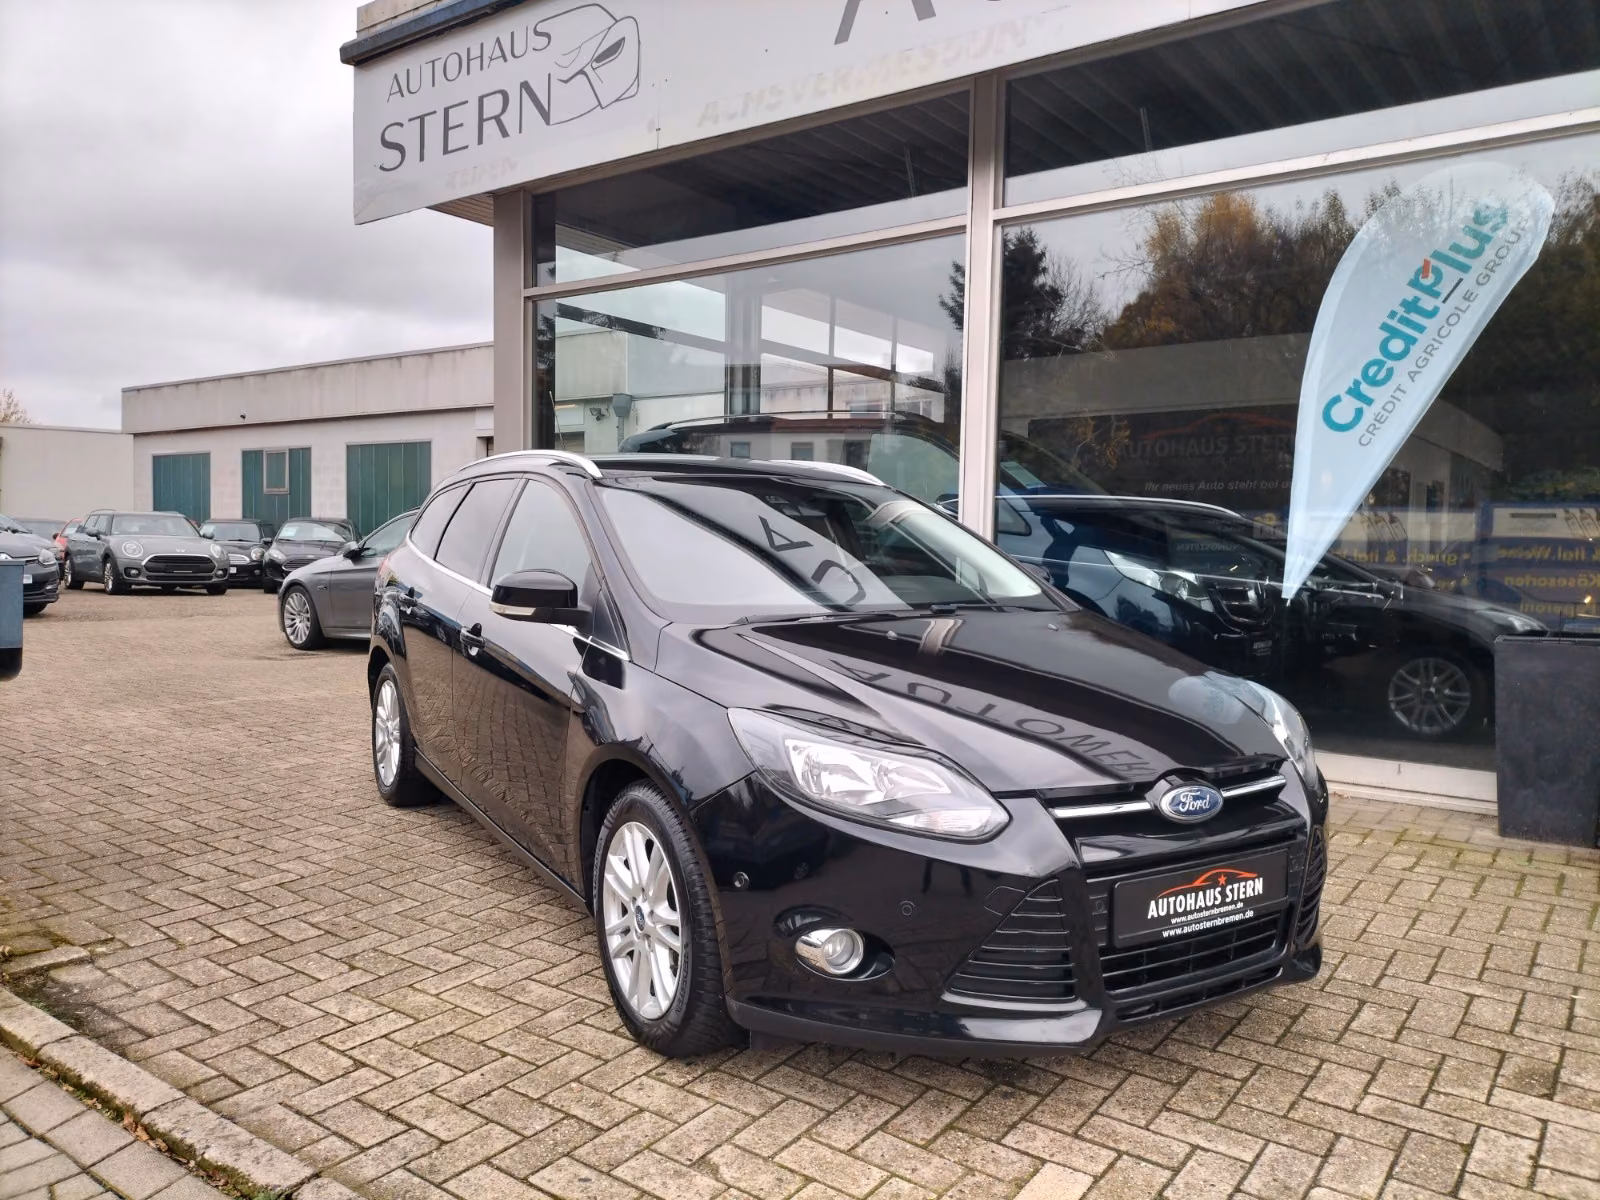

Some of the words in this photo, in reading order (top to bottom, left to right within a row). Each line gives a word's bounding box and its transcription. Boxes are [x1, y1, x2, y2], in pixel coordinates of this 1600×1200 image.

[387, 22, 552, 103] AUTOHAUS
[379, 73, 552, 172] STERN
[1322, 202, 1508, 433] CreditPlus
[1358, 384, 1407, 447] CRÉDIT
[1407, 290, 1479, 383] AGRICOLE
[1476, 217, 1530, 287] GROUP
[1117, 437, 1228, 459] AUTOHAUS
[1145, 481, 1159, 492] Ihr
[1162, 482, 1194, 492] neues
[1198, 480, 1225, 491] Auto
[1228, 480, 1258, 490] steht
[1179, 791, 1210, 812] Ford
[1148, 887, 1222, 919] AUTOHAUS
[1225, 877, 1263, 902] STERN
[1171, 902, 1243, 924] www.autosternbremen.de
[1162, 910, 1254, 938] www.autosternbremen.de
